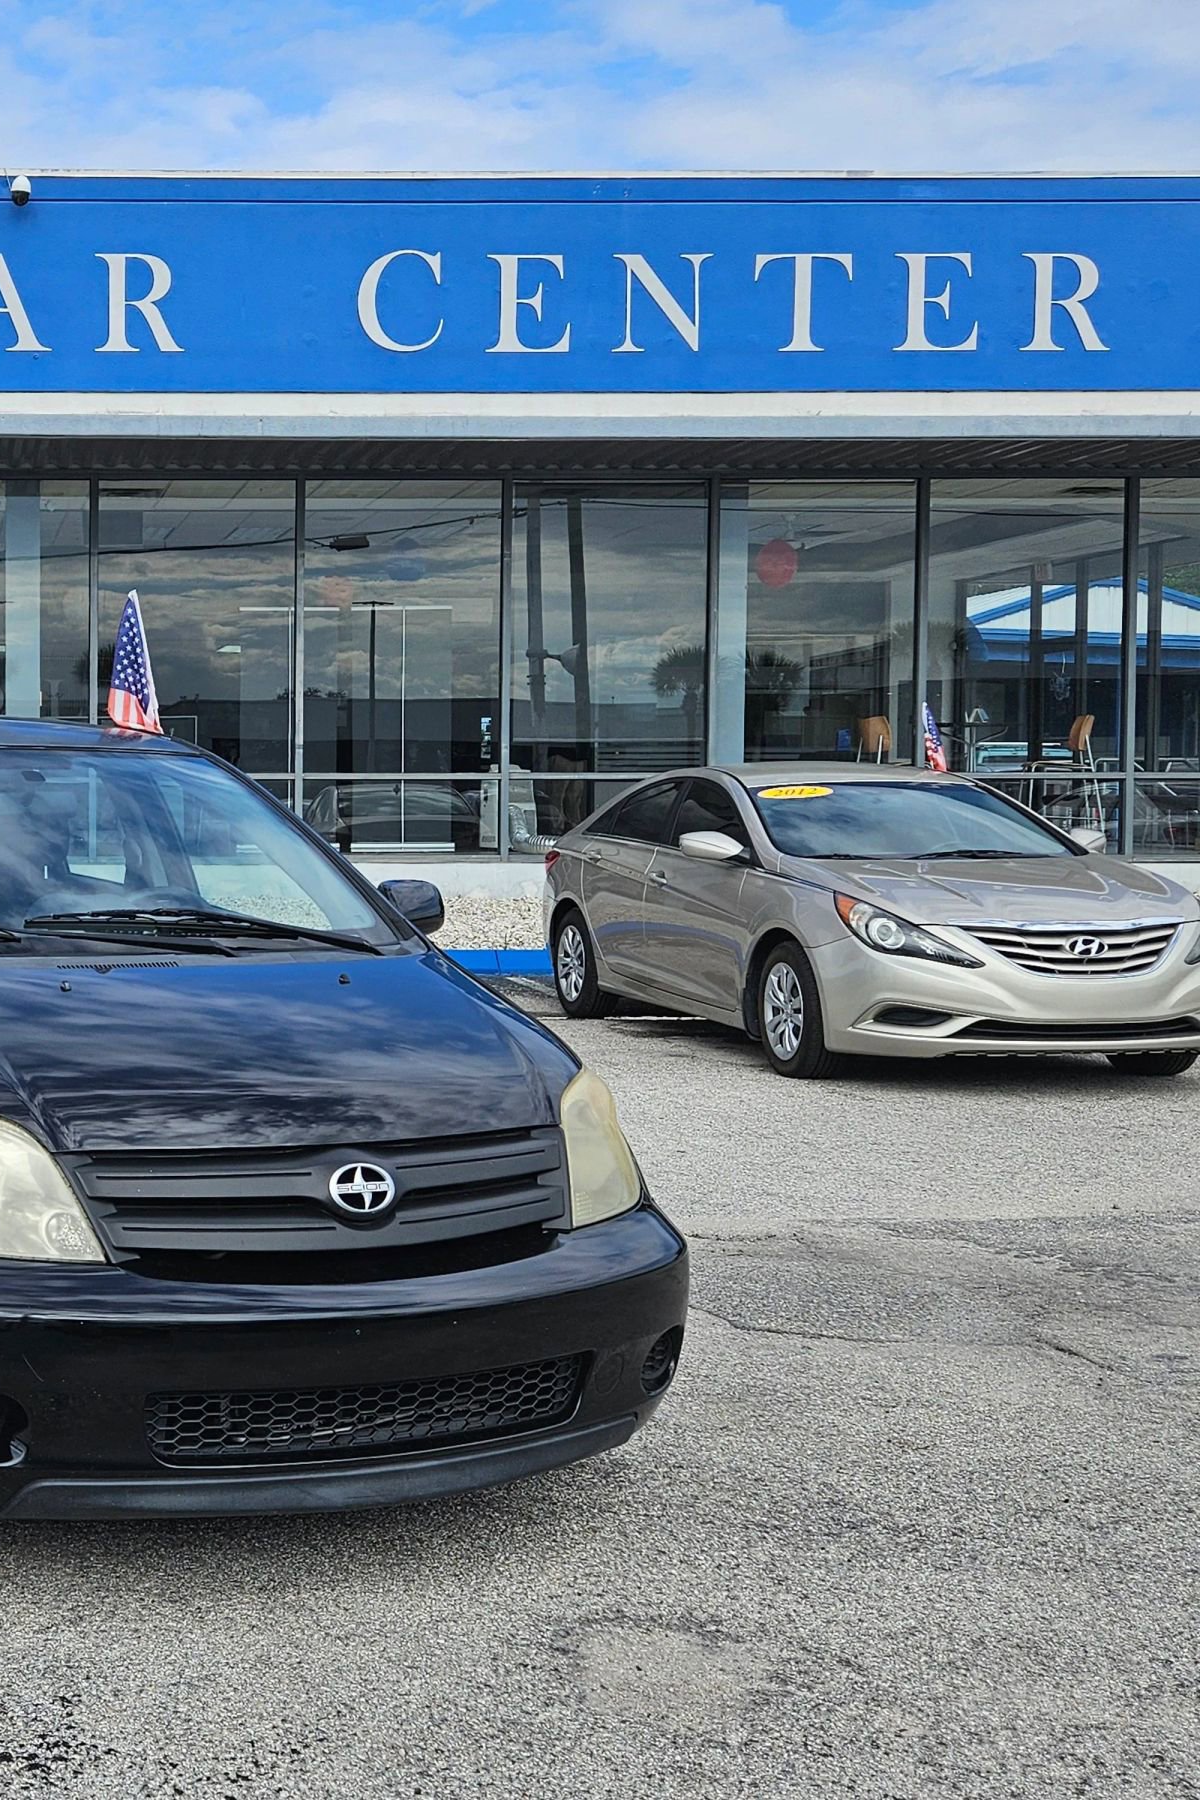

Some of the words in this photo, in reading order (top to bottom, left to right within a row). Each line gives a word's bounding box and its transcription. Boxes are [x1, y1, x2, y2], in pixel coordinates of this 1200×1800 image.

[358, 249, 1110, 353] CENTER
[773, 788, 817, 796] 2012
[336, 1183, 389, 1192] SCION
